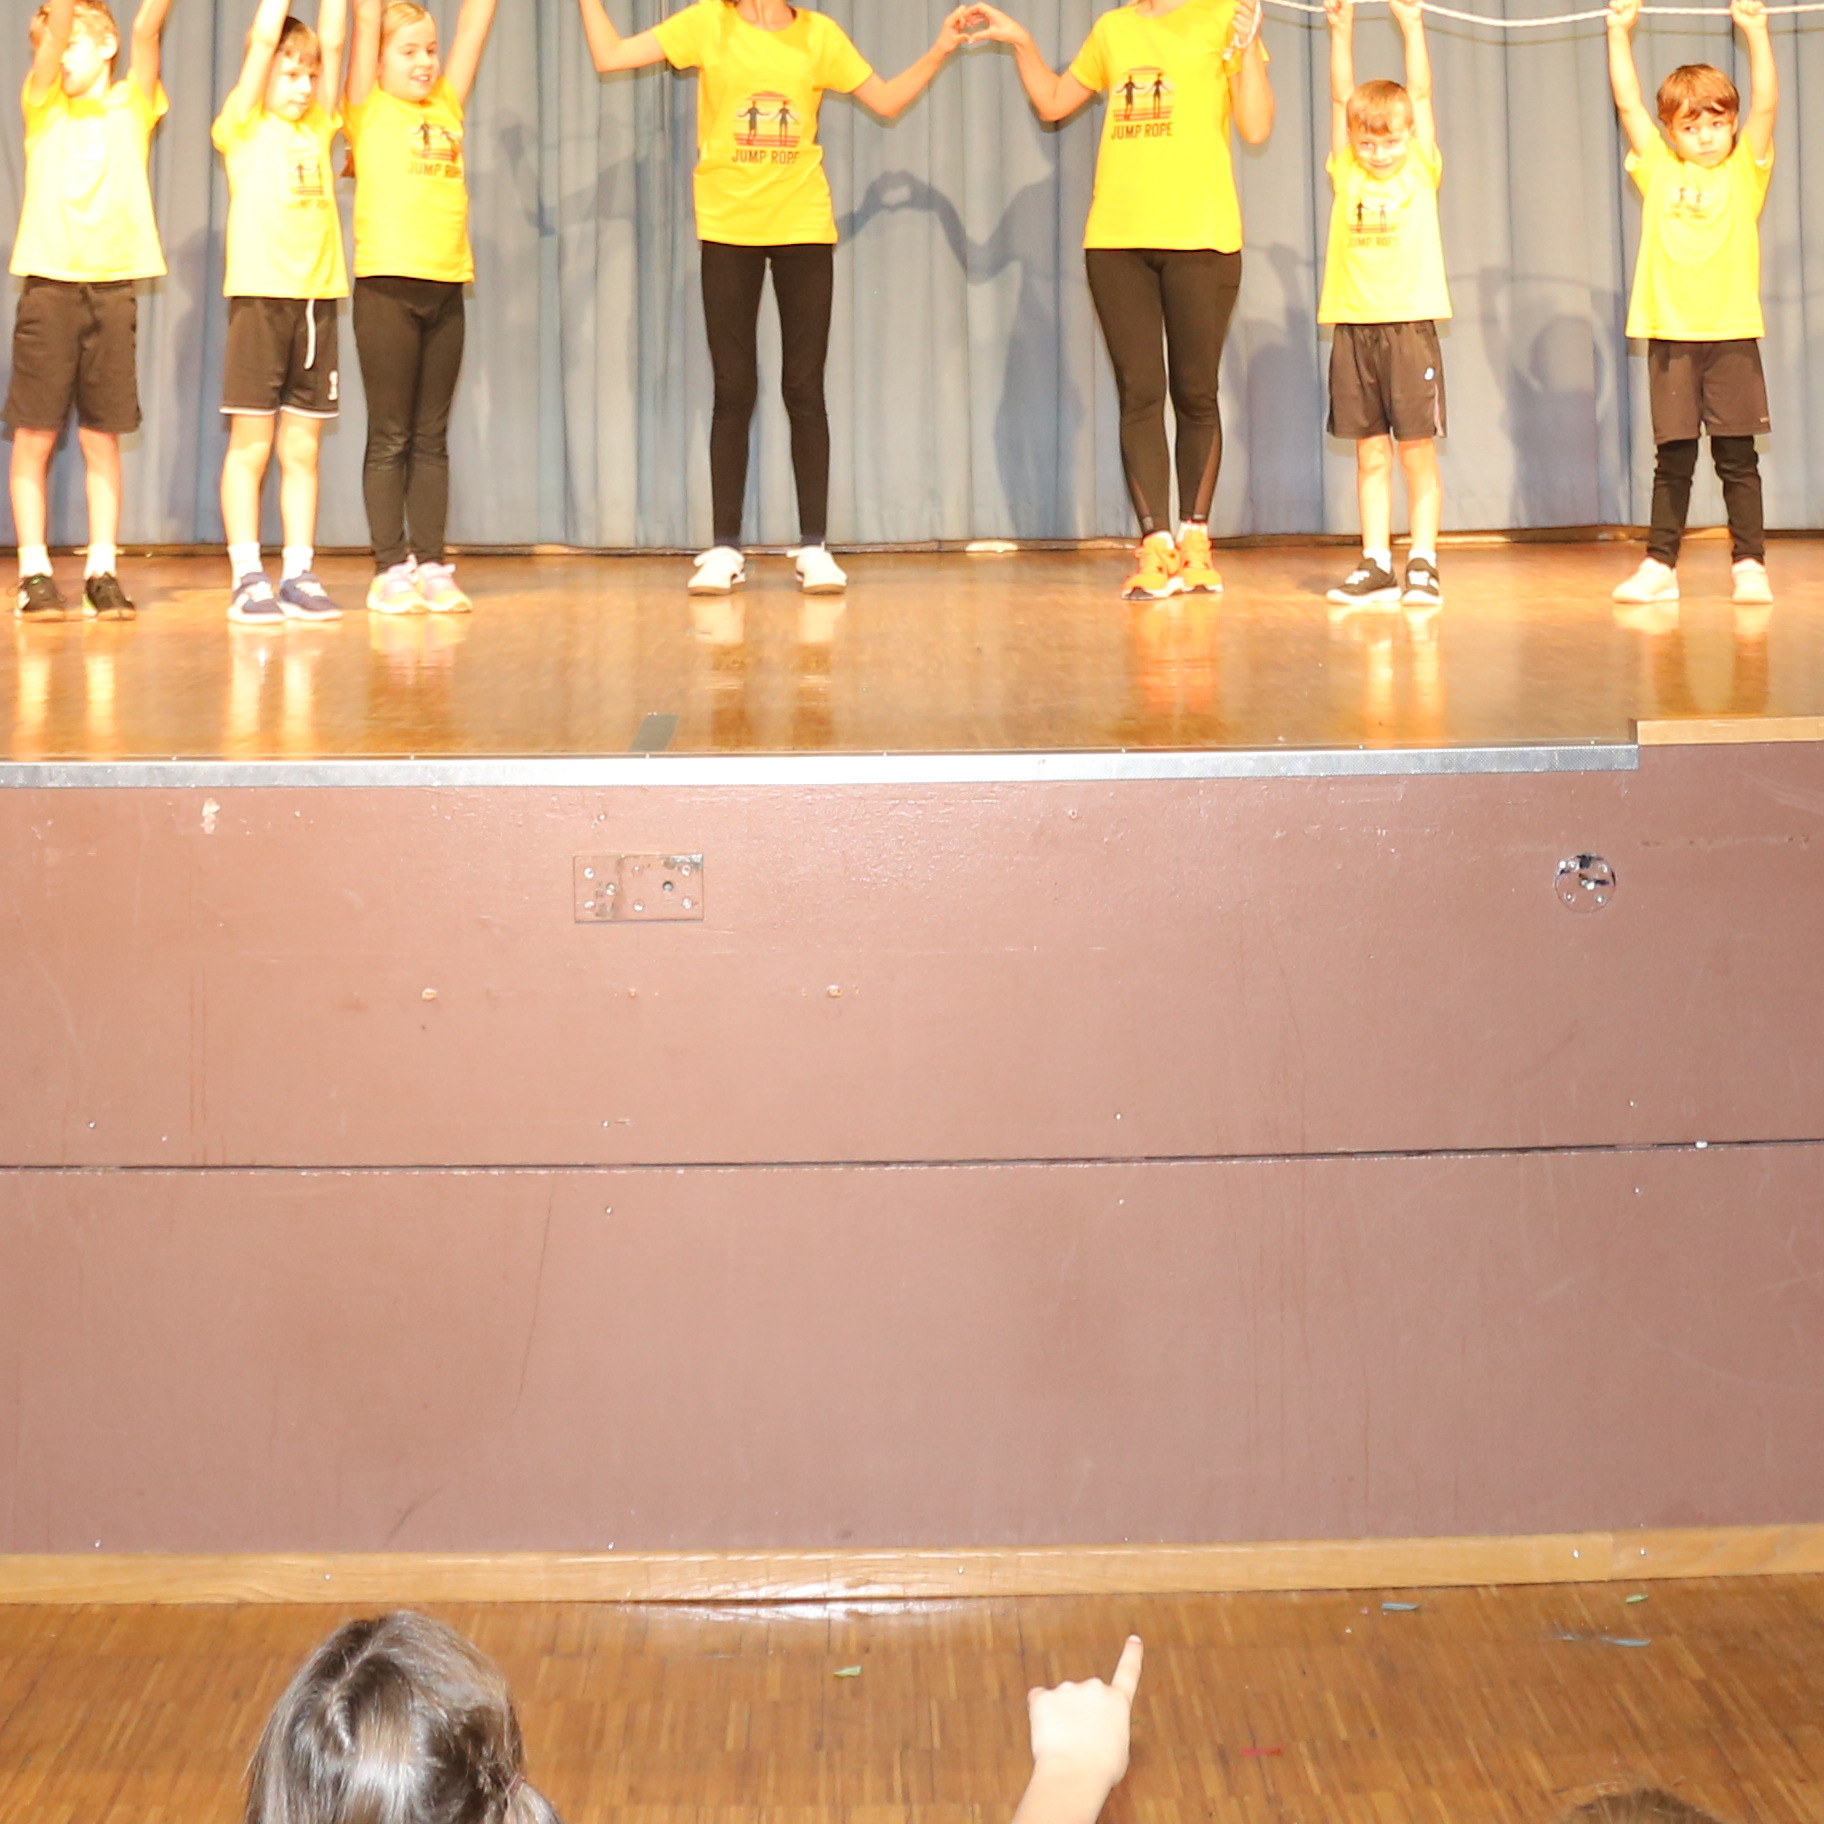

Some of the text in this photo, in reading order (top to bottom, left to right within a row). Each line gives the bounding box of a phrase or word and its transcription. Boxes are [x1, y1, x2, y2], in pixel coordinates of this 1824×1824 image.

[1110, 121, 1173, 140] JUMP ROPE
[731, 148, 767, 164] JUMP
[407, 161, 441, 177] JUMP
